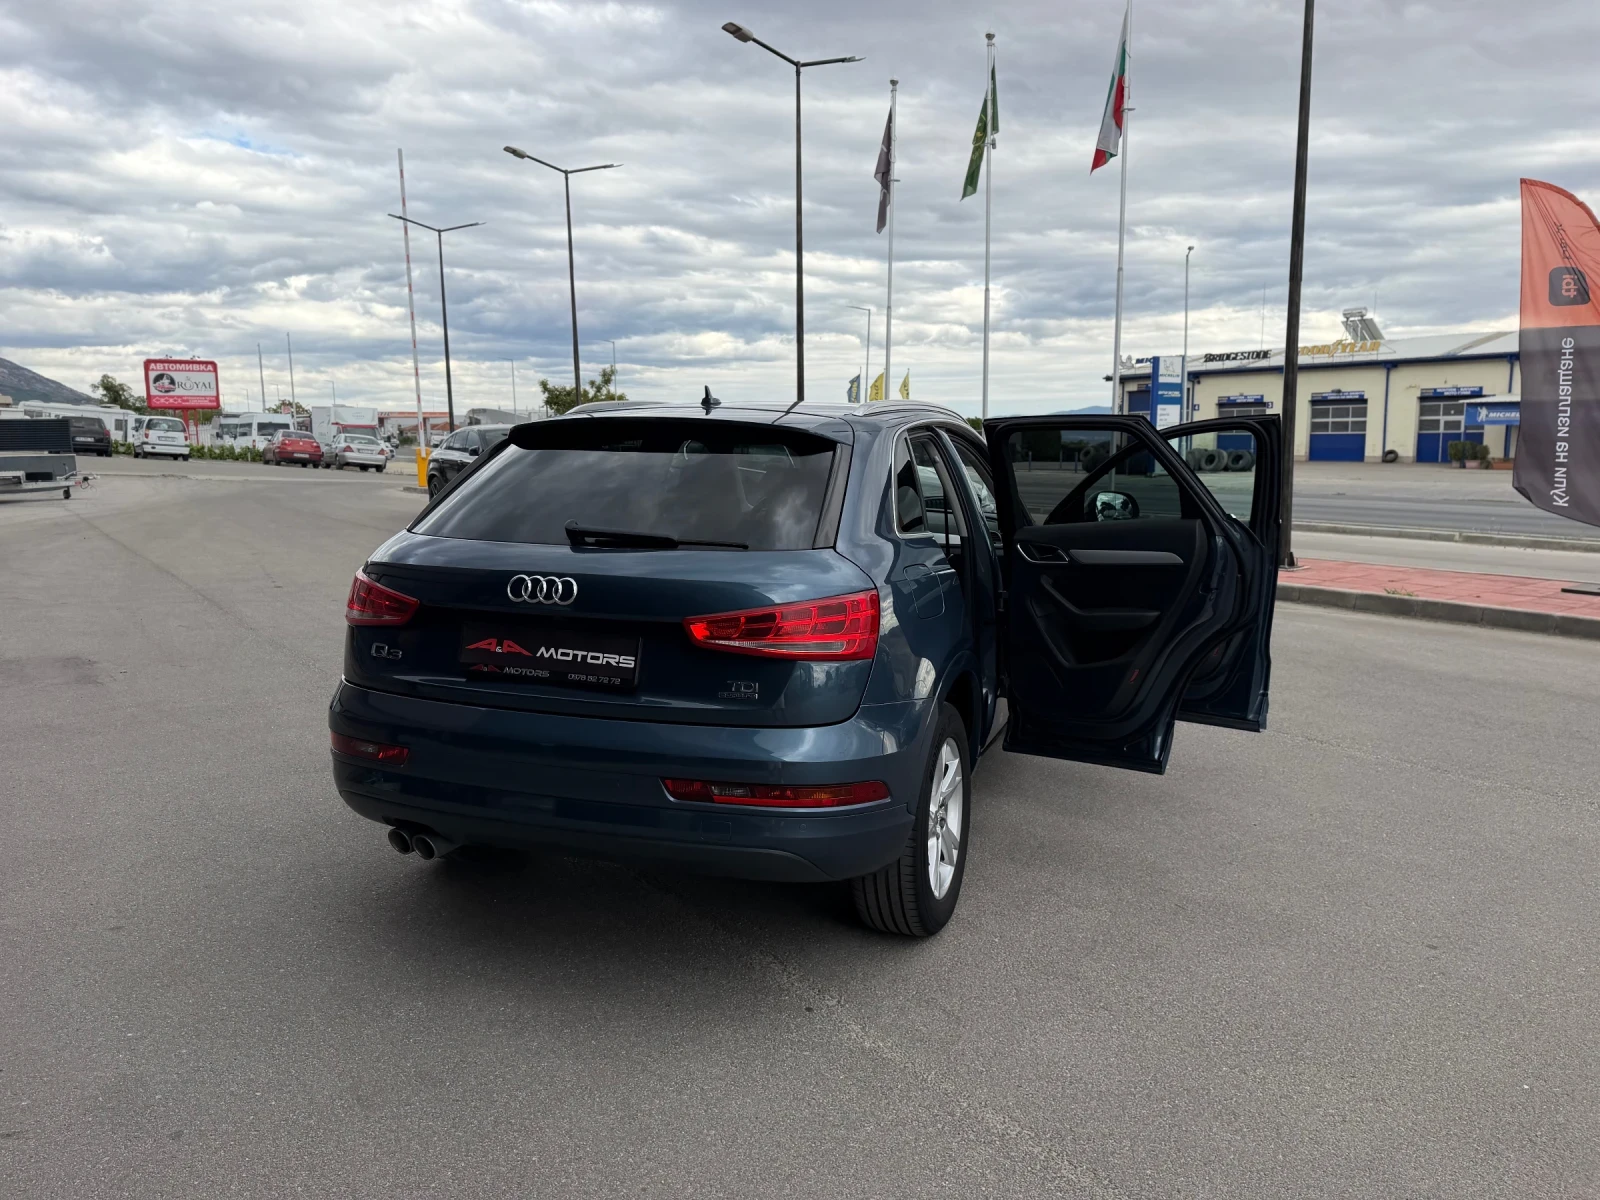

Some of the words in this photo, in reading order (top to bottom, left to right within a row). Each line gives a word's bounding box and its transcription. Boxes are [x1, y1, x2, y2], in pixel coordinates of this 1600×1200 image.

[1298, 339, 1380, 357] OODYEAR
[1203, 350, 1272, 363] BRIDGESTONE
[149, 363, 214, 371] АВТОМИВКА
[176, 381, 214, 391] ROYAL
[371, 642, 402, 660] Q3
[536, 646, 636, 668] MOTORS
[503, 666, 550, 677] MOTORS
[599, 676, 609, 684] 72
[610, 677, 621, 685] 72
[726, 680, 759, 693] TDI
